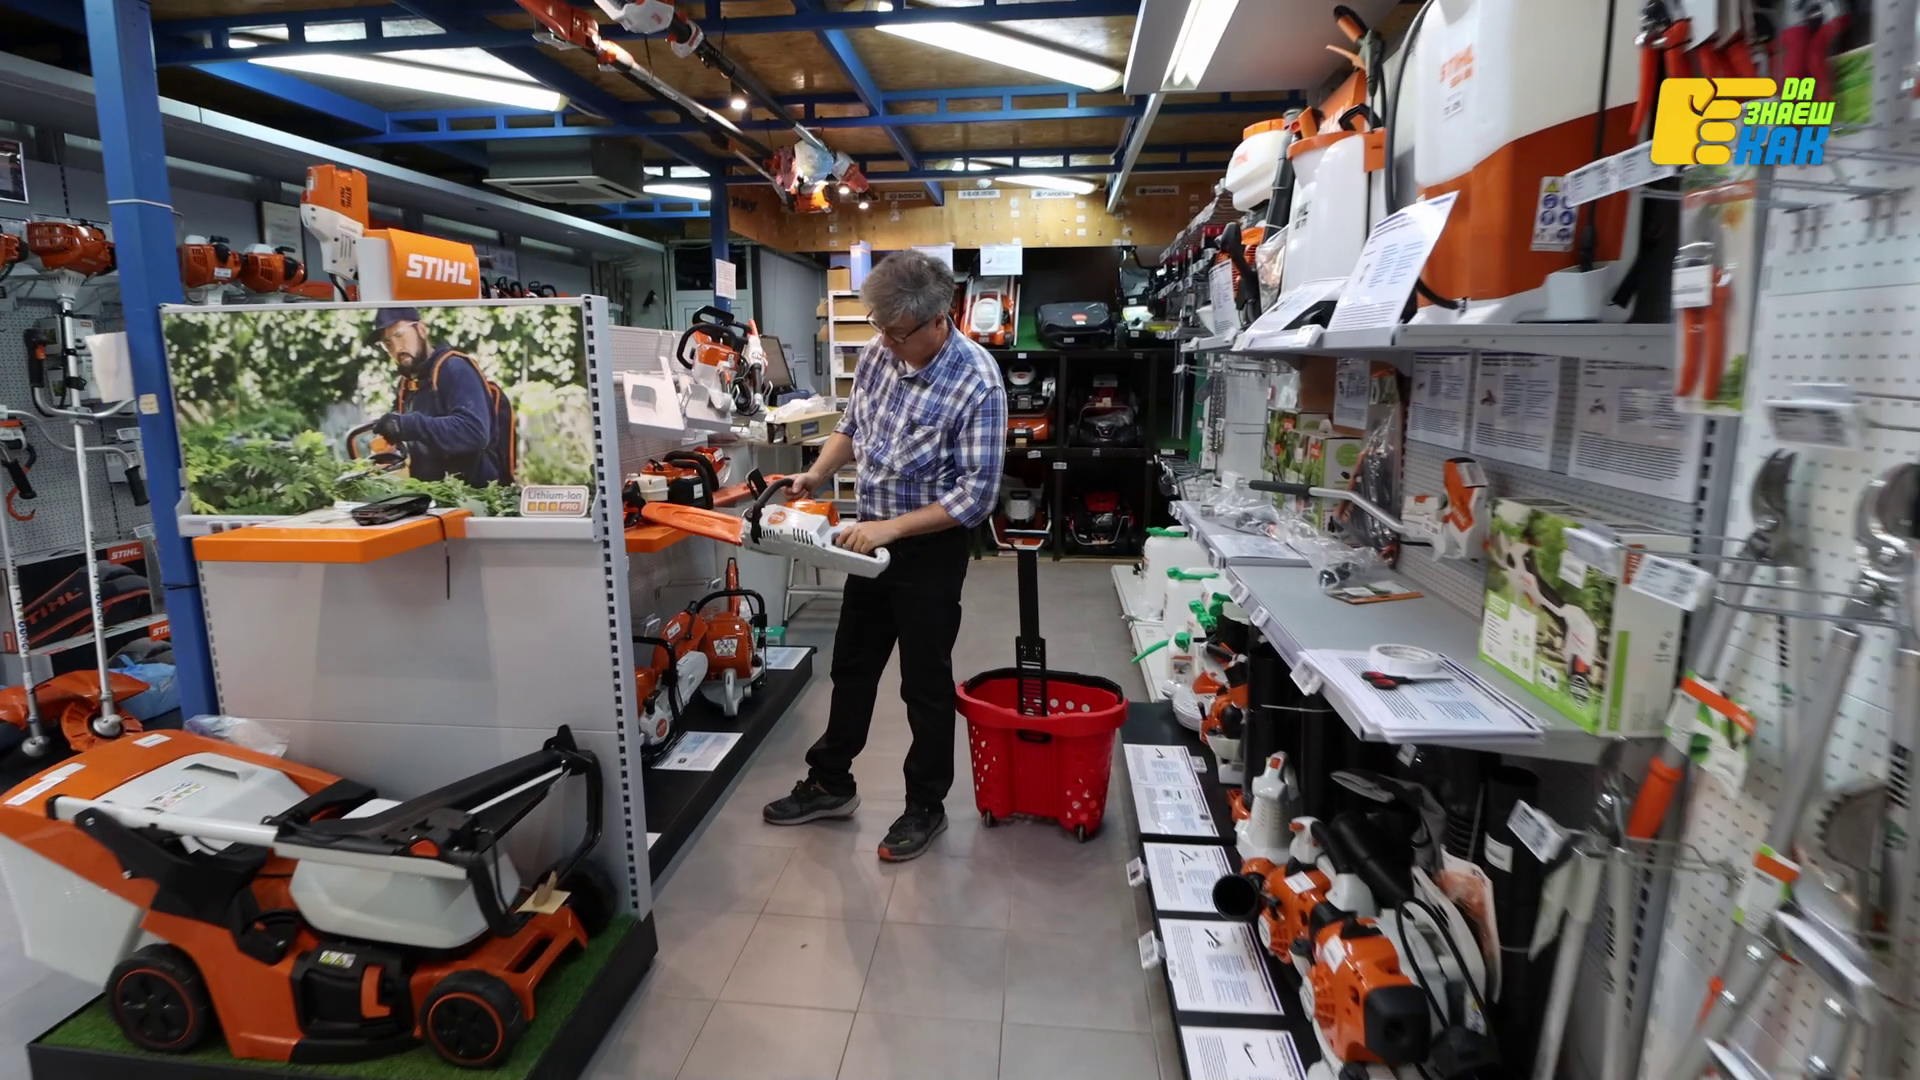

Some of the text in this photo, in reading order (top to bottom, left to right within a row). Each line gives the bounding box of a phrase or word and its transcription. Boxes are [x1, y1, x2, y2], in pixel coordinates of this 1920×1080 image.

[406, 254, 472, 285] STIHL
[528, 491, 582, 499] Lithium-Ion
[561, 503, 578, 511] PRO
[111, 547, 141, 560] STIHL
[26, 591, 84, 625] TIHL
